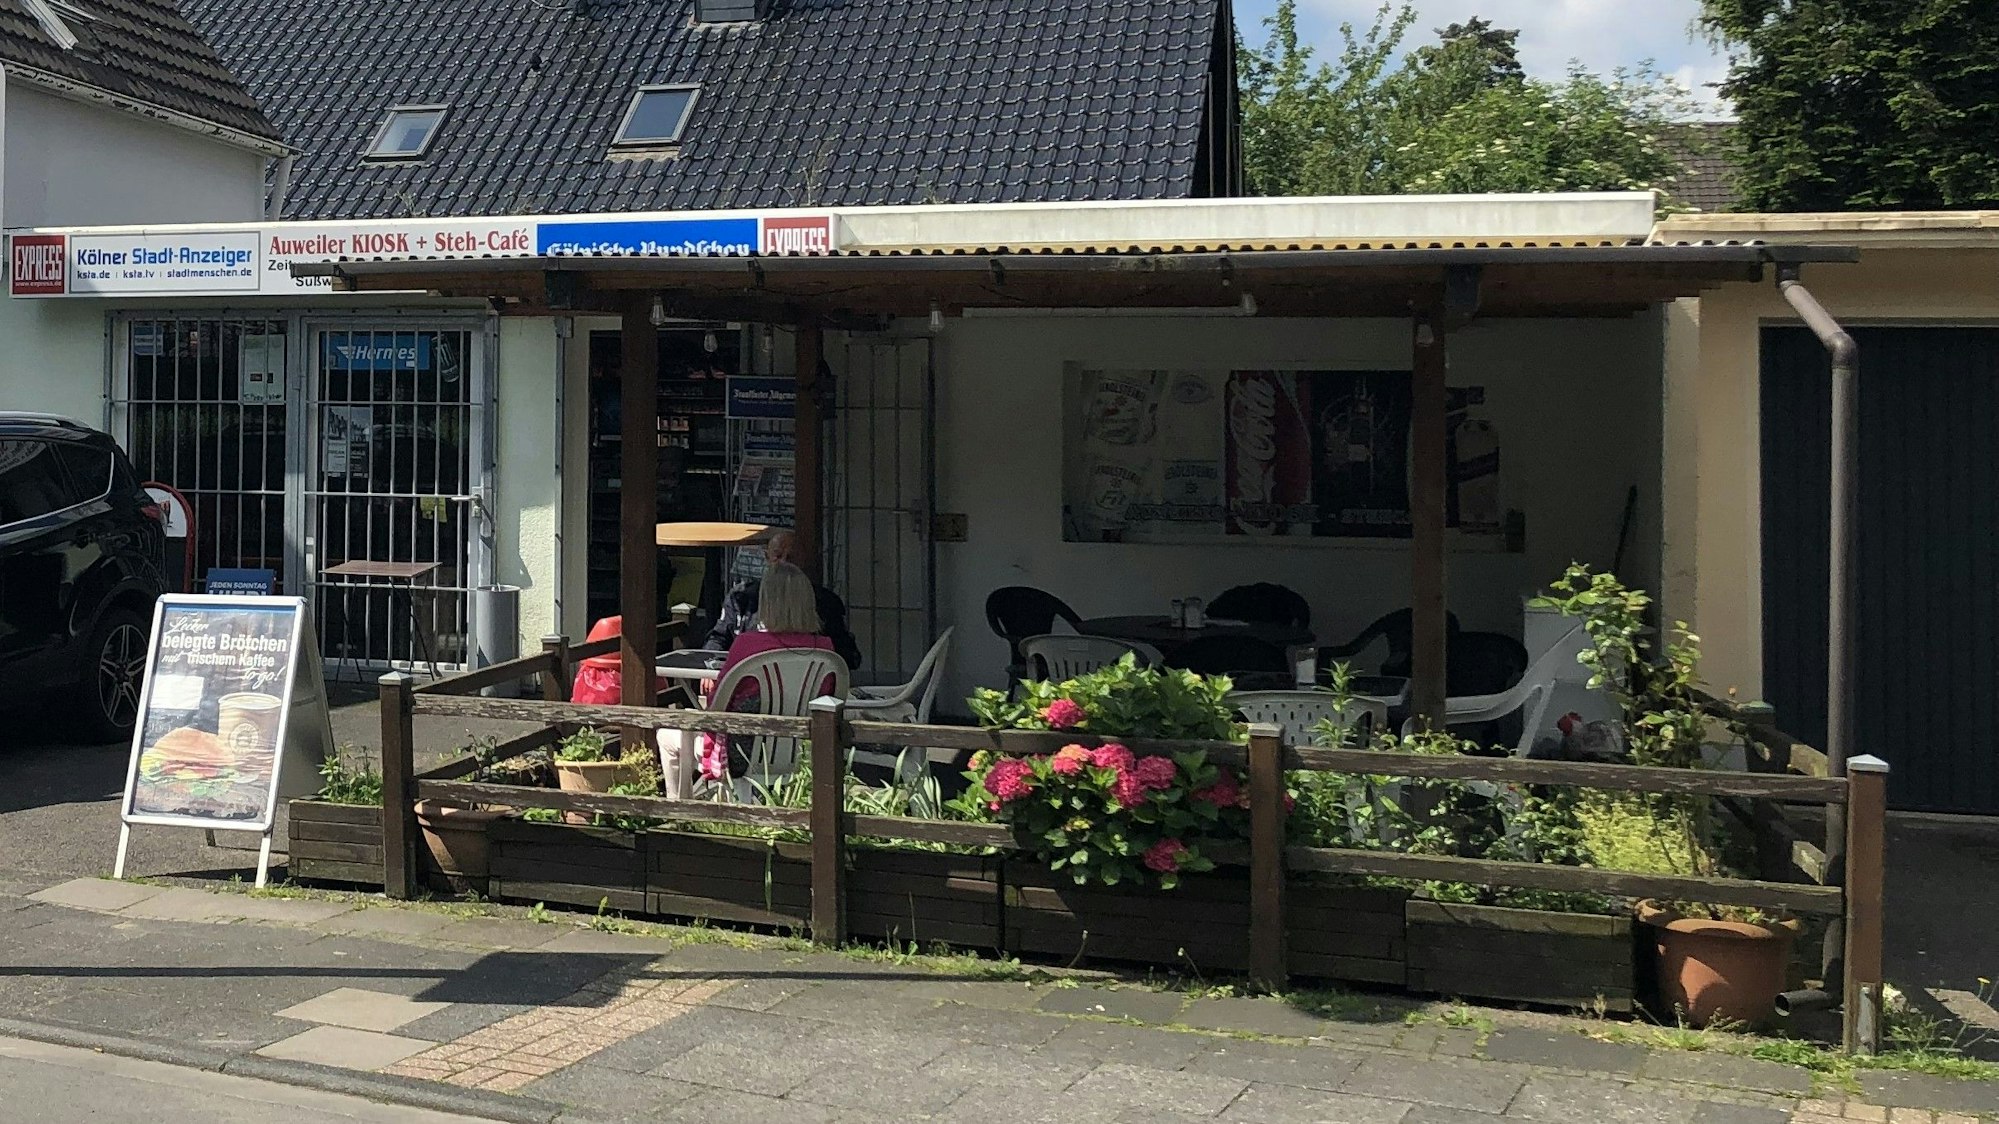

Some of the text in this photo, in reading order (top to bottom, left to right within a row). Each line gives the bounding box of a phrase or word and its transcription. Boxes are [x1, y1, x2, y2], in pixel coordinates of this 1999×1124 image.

[269, 228, 529, 255] Auweiler KIOSK + Steh-Café
[767, 227, 827, 255] EXPRESS
[14, 244, 63, 281] EXPRESS
[77, 246, 252, 267] Kölner Stadt-Anzeiger
[77, 269, 111, 280] ksta.de
[123, 269, 155, 279] ksta.tv
[167, 267, 252, 279] stadtmenschen.de
[355, 345, 416, 360] Hermes
[209, 581, 268, 590] JEDEN SONNTAG
[166, 615, 210, 634] Lecker
[161, 632, 287, 652] belegte Brötchen
[161, 651, 275, 668] mit frischem Kaffee
